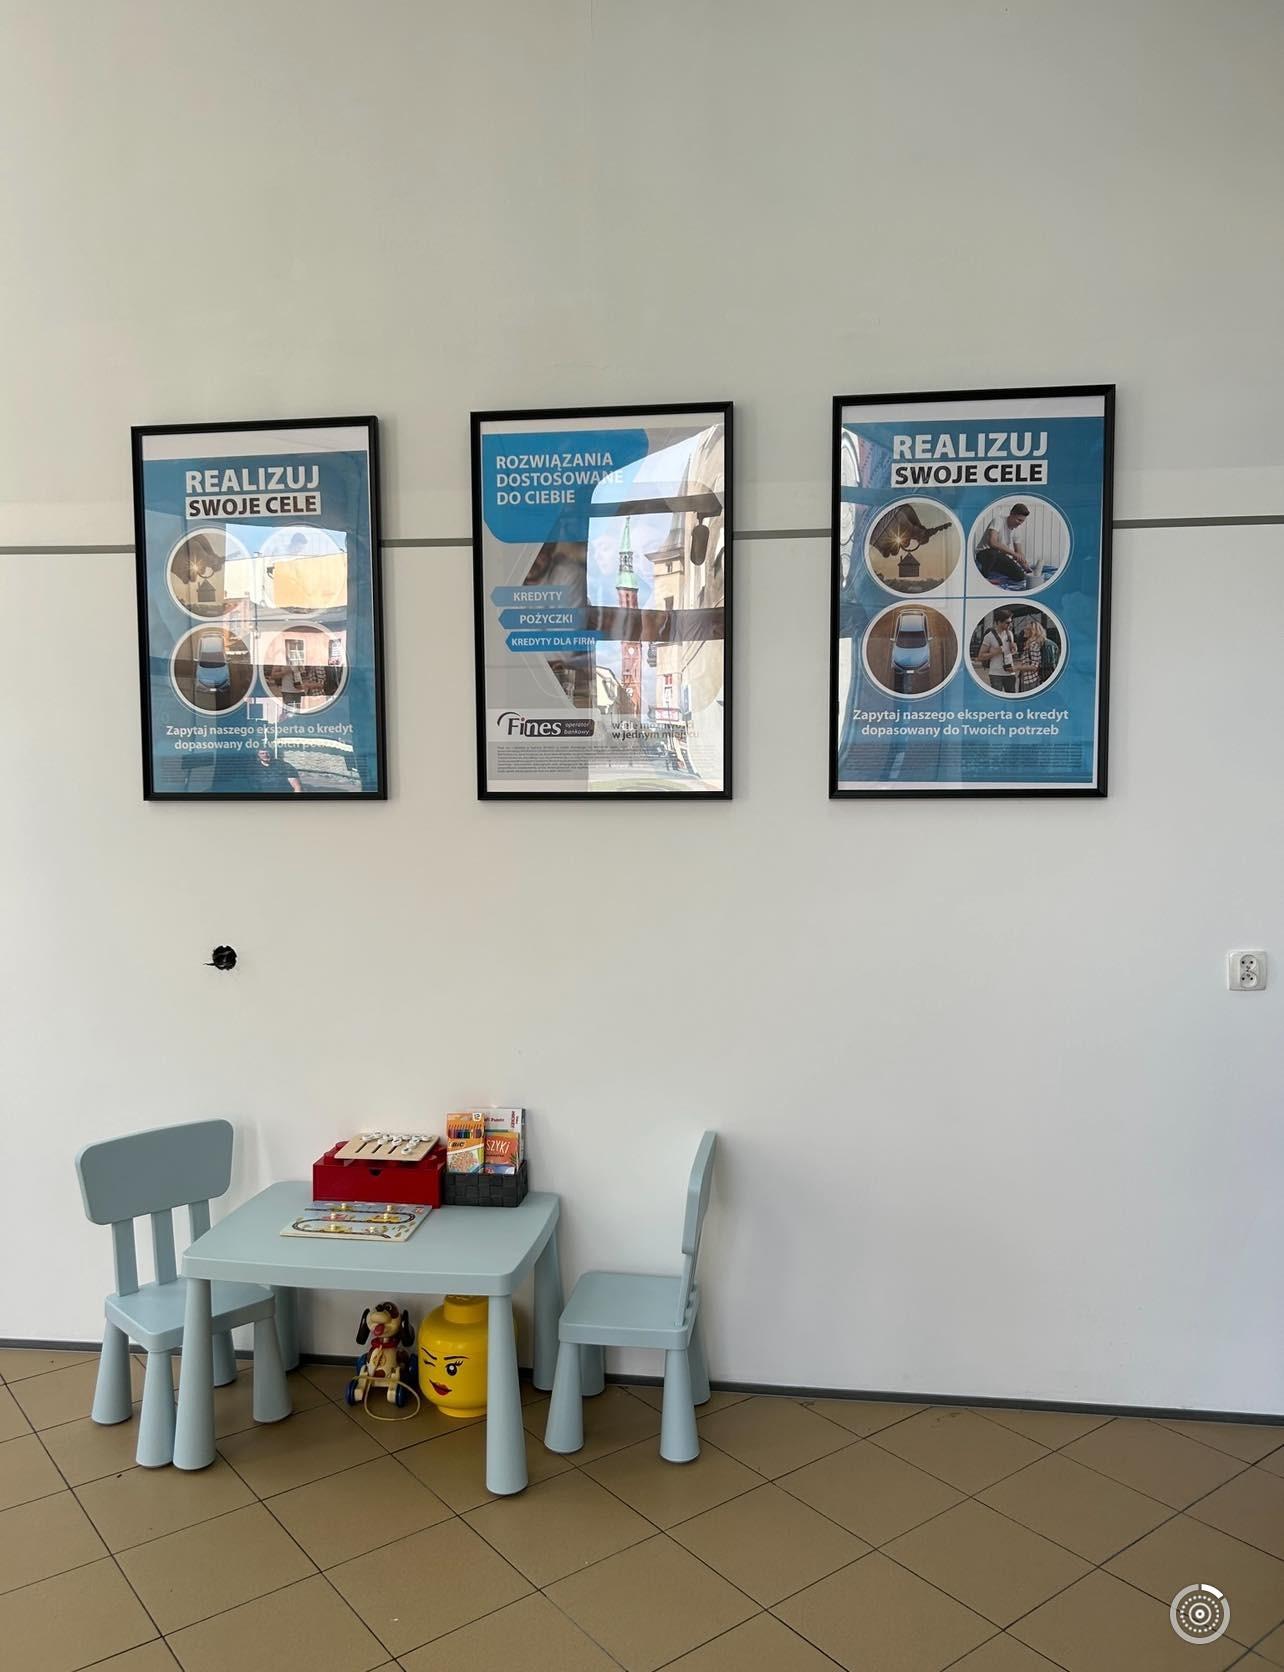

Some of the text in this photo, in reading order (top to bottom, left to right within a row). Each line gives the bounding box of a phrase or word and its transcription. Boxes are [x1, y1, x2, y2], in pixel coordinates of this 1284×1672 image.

[893, 432, 1048, 460] REALIZUJ
[496, 452, 613, 471] ROZWIĄZANIA
[185, 465, 319, 494] REALIZUJ
[496, 470, 624, 488] DOSTOSOWANE
[895, 463, 1043, 485] SWOJE CELE
[496, 489, 576, 505] DO CIEBIE
[189, 495, 317, 517] SWOJE CELE
[513, 591, 562, 602] KREDYTY
[519, 612, 573, 624] POŻYCZKI
[511, 636, 595, 646] KREDYTY DLA FIRM
[853, 708, 1068, 722] Zapytaj naszego eksperta o kredyt
[166, 724, 208, 738] Zapytaj
[209, 725, 254, 737] naszego
[307, 724, 315, 733] o
[317, 722, 354, 735] kredyt
[507, 717, 562, 736] Fines
[861, 723, 1059, 737] dopasowany do Twoich potrzeb
[612, 731, 620, 739] w
[621, 729, 660, 741] jednym
[174, 738, 243, 751] dopasowany
[245, 737, 260, 749] do
